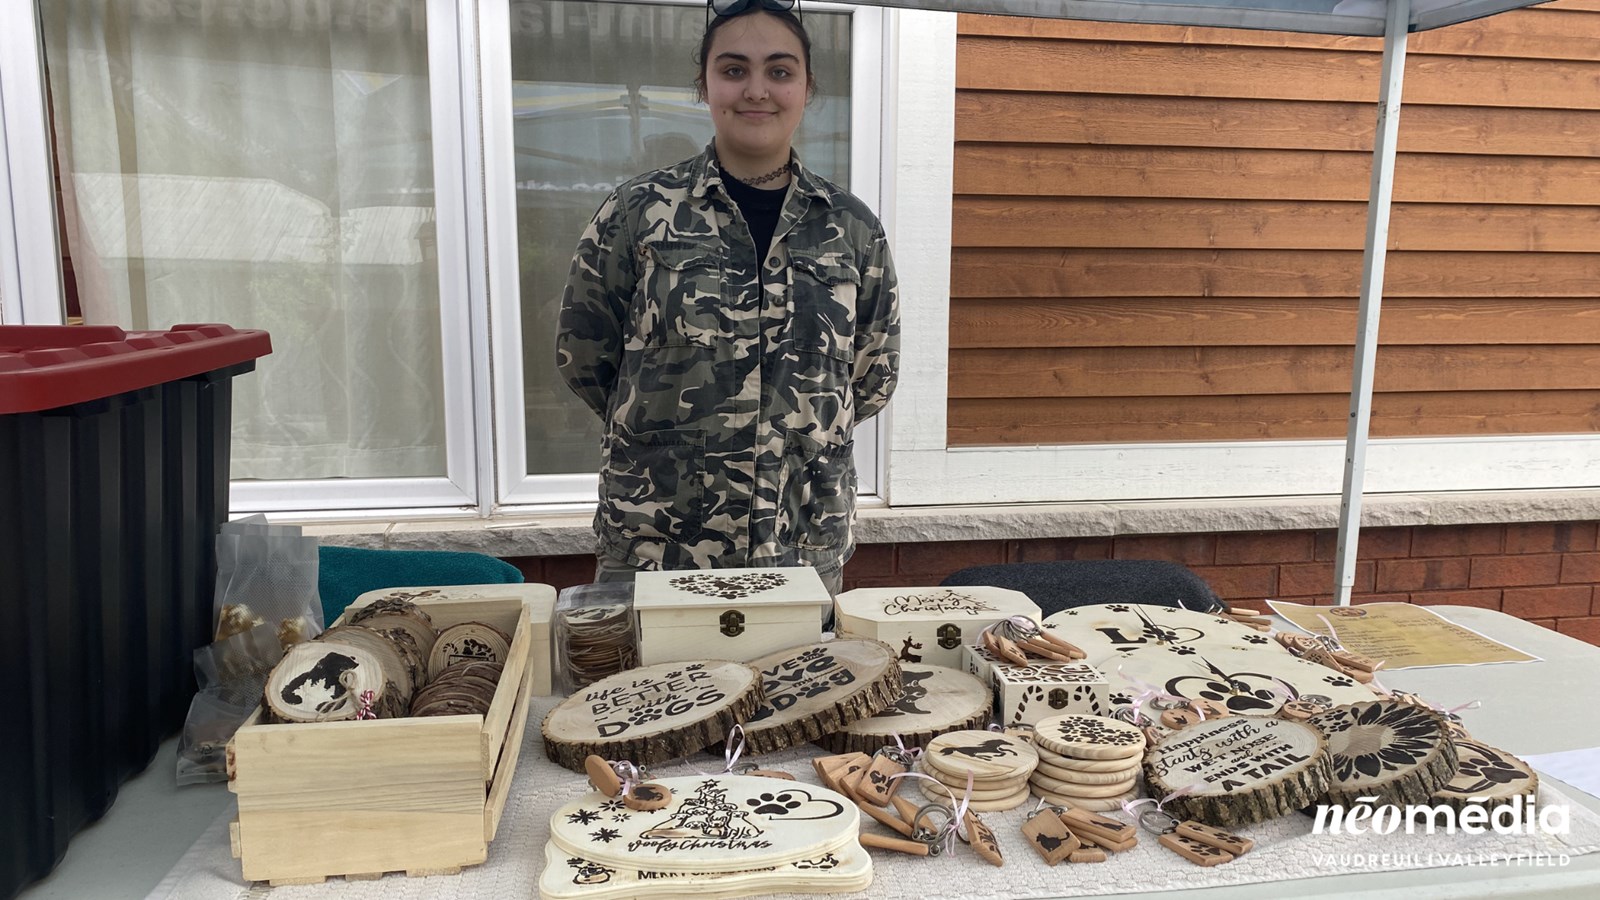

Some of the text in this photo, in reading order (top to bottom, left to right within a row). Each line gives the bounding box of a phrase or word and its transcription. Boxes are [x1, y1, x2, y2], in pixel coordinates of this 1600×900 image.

[884, 603, 979, 616] Christmas
[894, 594, 960, 606] Merry
[585, 679, 654, 702] life is
[592, 671, 712, 715] BETTER
[628, 693, 681, 713] with
[1156, 720, 1279, 777] starts with a
[1158, 718, 1248, 755] Happiness
[1183, 733, 1278, 773] WET NOSE
[1203, 743, 1294, 783] ENDS WITH
[1230, 751, 1254, 763] and
[1221, 753, 1311, 793] A TAIL
[680, 839, 773, 851] Christmas
